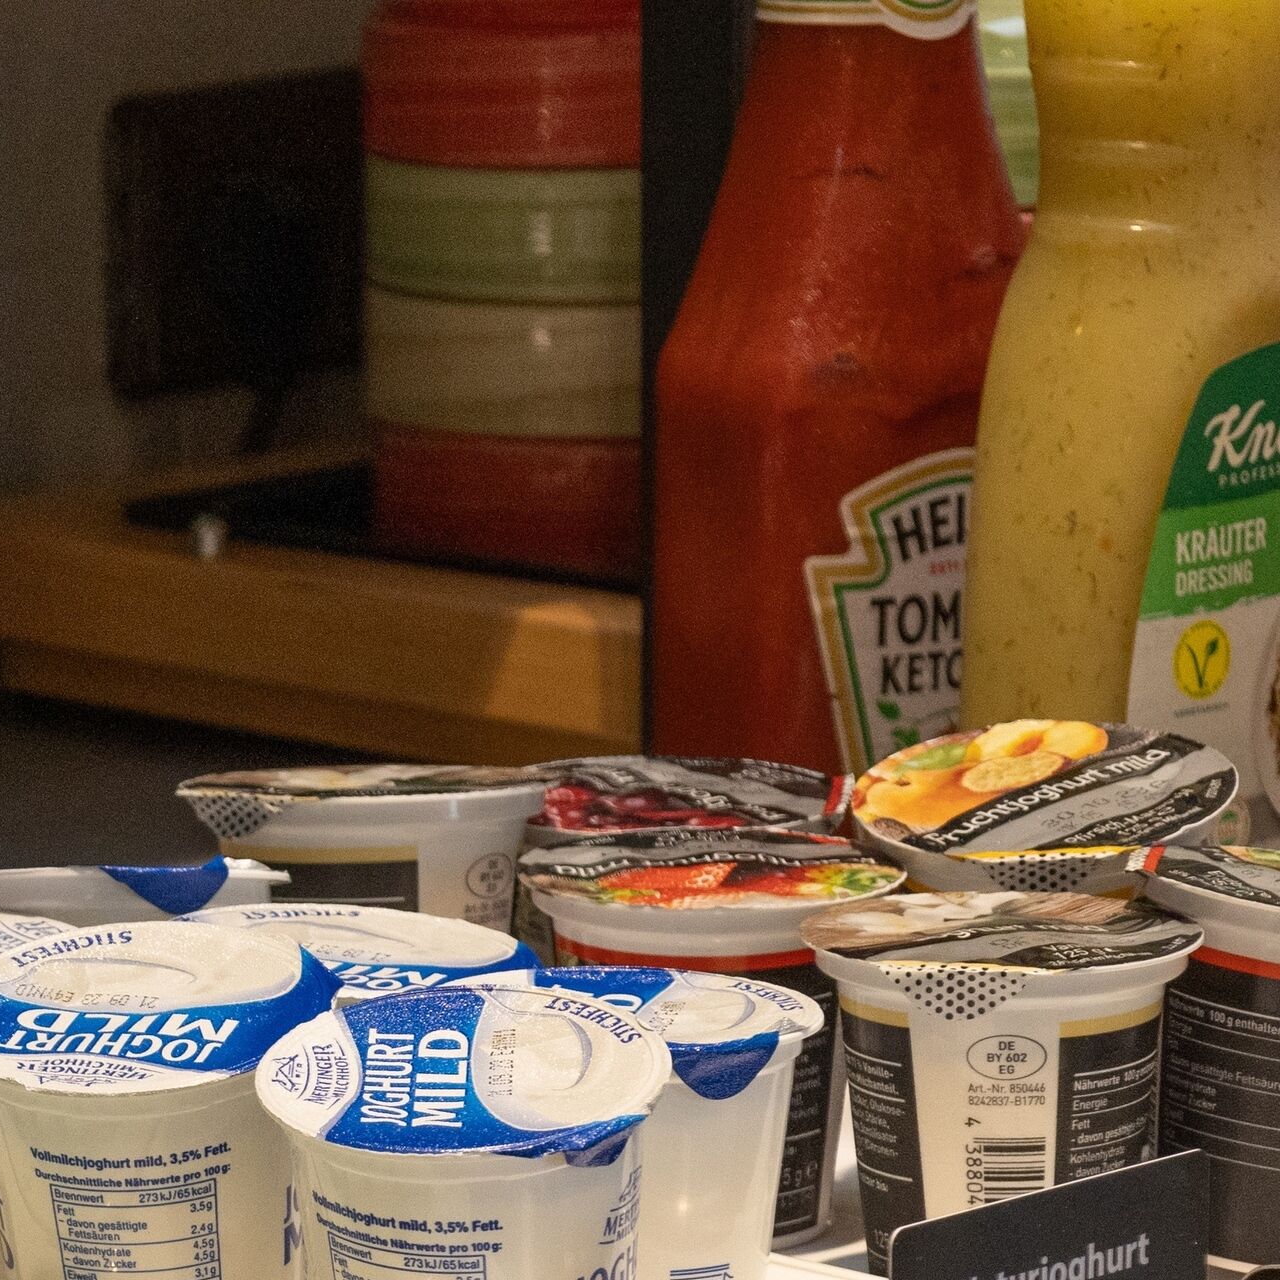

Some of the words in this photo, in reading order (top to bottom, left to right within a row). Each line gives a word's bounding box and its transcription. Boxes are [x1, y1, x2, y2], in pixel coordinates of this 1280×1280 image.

[1175, 518, 1267, 565] KRÄUTER
[1175, 559, 1254, 597] DRESSING
[11, 930, 133, 968] STICHFEST
[16, 1008, 240, 1043] MILD
[544, 996, 643, 1045] STICHFEST
[998, 1040, 1015, 1051] DE
[38, 1057, 135, 1075] MILCHHOF
[986, 1053, 1002, 1063] BY
[1006, 1053, 1028, 1063] 602
[15, 1061, 147, 1080] MERTINGER
[305, 1042, 335, 1106] MERTINGER
[331, 1056, 351, 1102] MILCHHOF
[360, 1028, 415, 1127] JOGHURT
[411, 1029, 470, 1128] MILD
[999, 1065, 1015, 1075] EG
[968, 1084, 1006, 1093] Art.-Nr.
[1009, 1083, 1046, 1093] 850446
[1074, 1074, 1120, 1091] Nährwerte
[1072, 1098, 1108, 1111] Energie
[964, 1116, 981, 1128] 4
[1071, 1119, 1090, 1131] Fett
[1077, 1131, 1104, 1144] davon
[30, 1147, 131, 1171] Vollmilchjoghurt
[134, 1157, 167, 1168] mild,
[170, 1150, 202, 1165] 3,5%
[204, 1141, 231, 1158] Fett.
[34, 1168, 123, 1188] Durchschnittliche
[125, 1174, 181, 1187] Nährwerte
[183, 1172, 201, 1183] pro
[54, 1188, 104, 1204] Brennwert
[56, 1204, 75, 1217] Fett
[312, 1190, 396, 1229] Vollmilchjoghurt
[399, 1216, 431, 1234] mild,
[434, 1221, 469, 1235] 3,5%
[472, 1220, 503, 1232] Fett.
[66, 1218, 96, 1229] davon
[98, 1220, 148, 1235] gesättigte
[68, 1228, 120, 1241] Fettsäuren
[316, 1213, 389, 1247] Durchschnittliche
[390, 1239, 446, 1252] Nährwerte
[449, 1245, 468, 1255] pro
[62, 1242, 131, 1258] Kohlenhydrate
[331, 1237, 373, 1260] Brennwert
[72, 1257, 101, 1267] davon
[103, 1258, 137, 1269] Zucker
